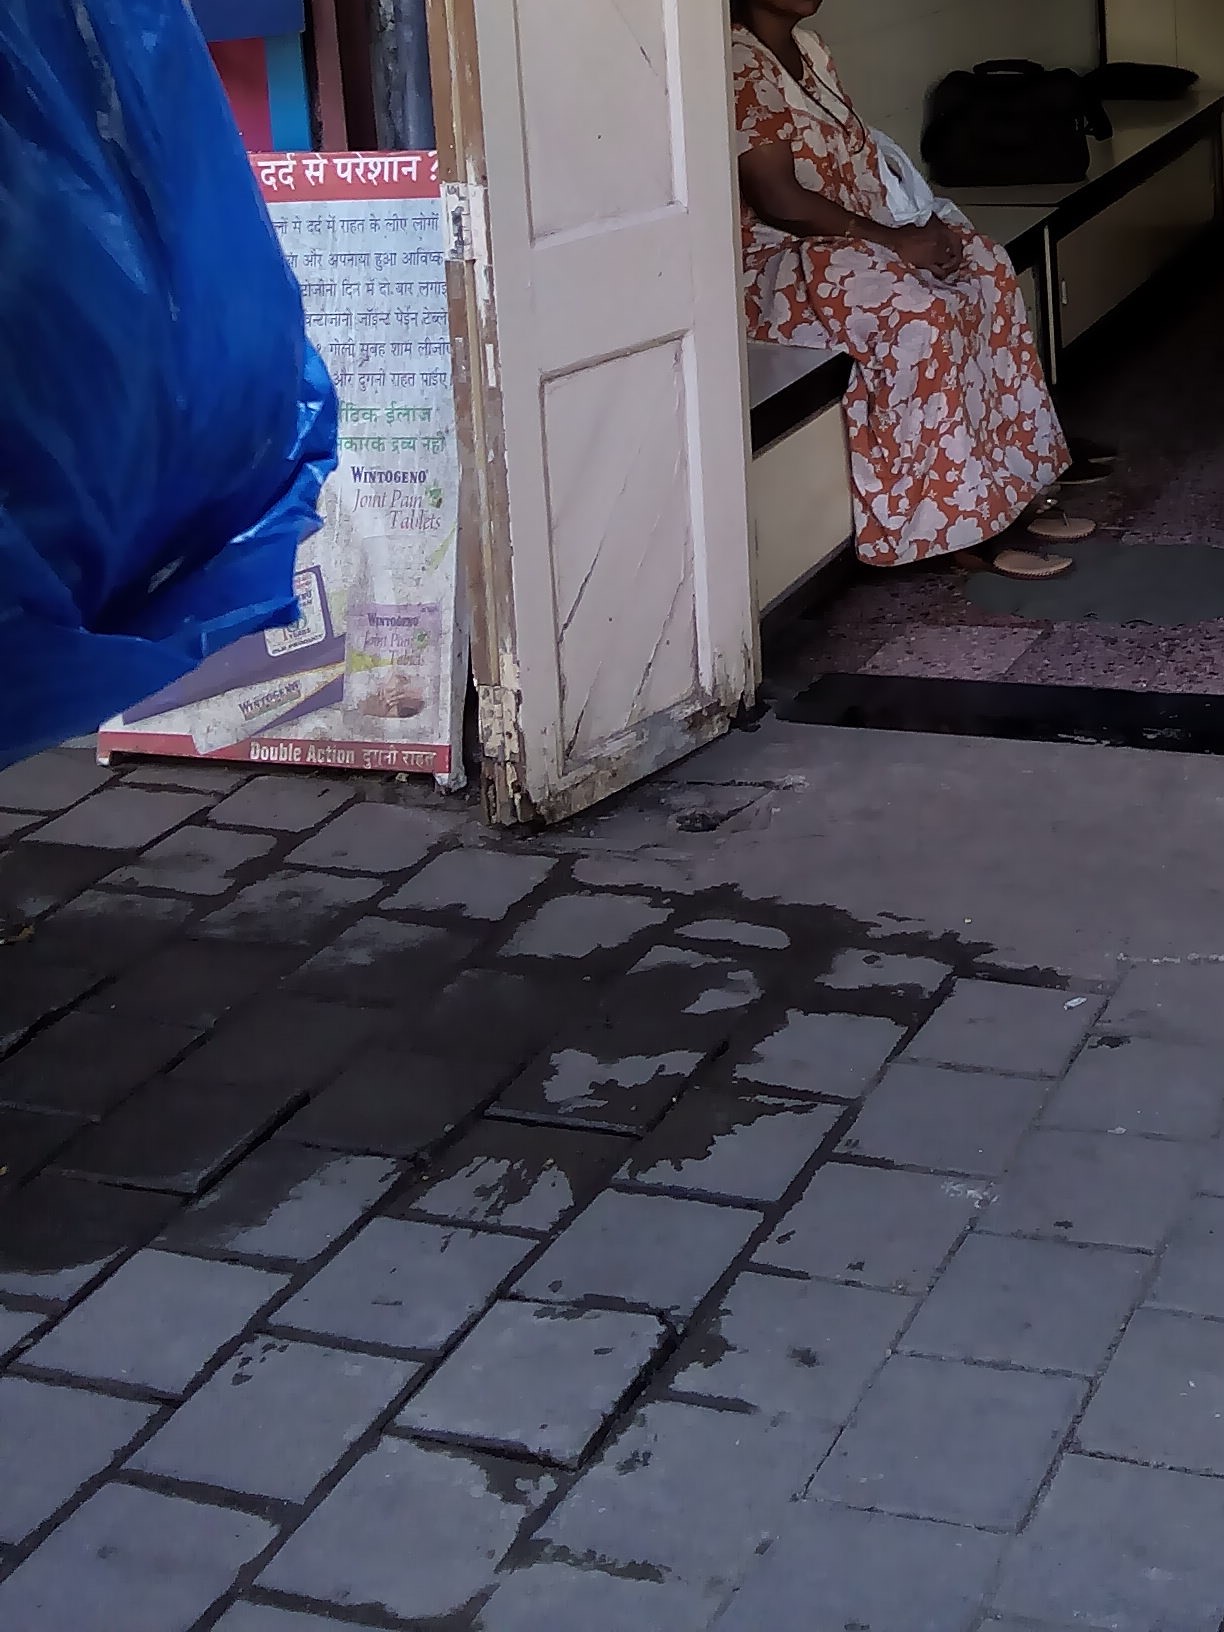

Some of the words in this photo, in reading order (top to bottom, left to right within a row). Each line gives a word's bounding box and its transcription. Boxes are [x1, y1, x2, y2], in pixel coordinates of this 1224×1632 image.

[302, 153, 329, 186] से
[333, 152, 422, 186] परेशान
[353, 489, 386, 512] Joint
[391, 490, 423, 508] Pain
[390, 509, 441, 530] Tablets
[250, 742, 300, 762] Double
[305, 744, 355, 764] Action
